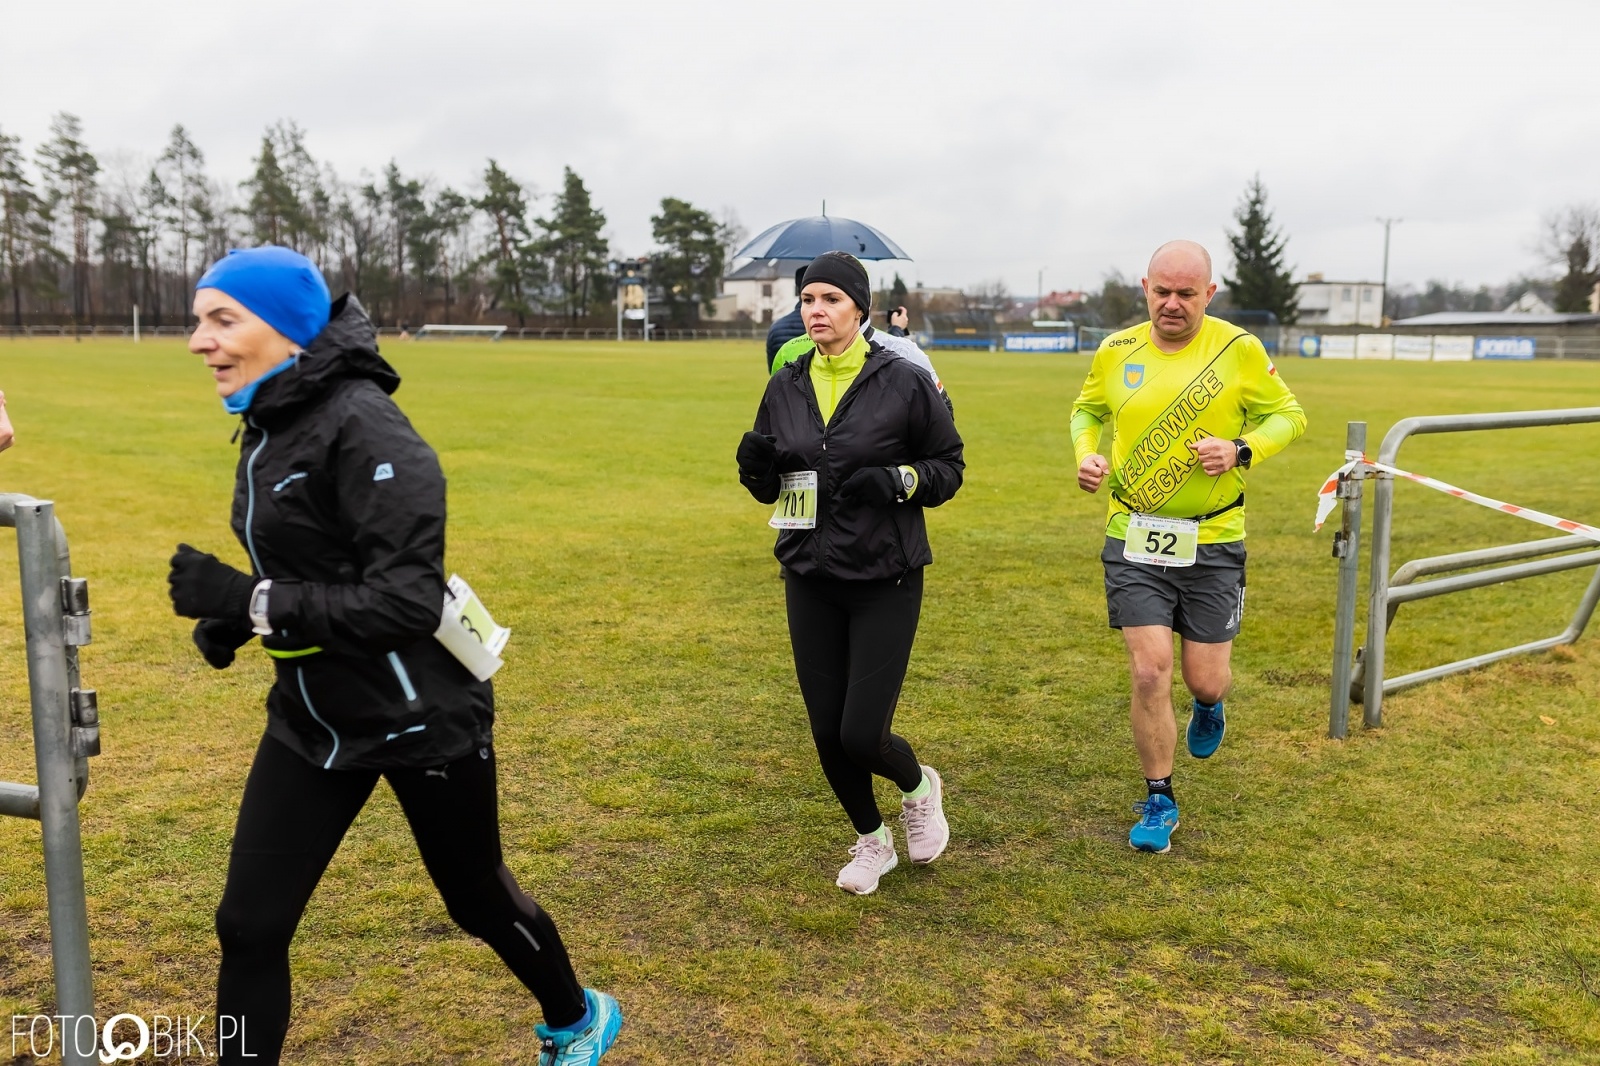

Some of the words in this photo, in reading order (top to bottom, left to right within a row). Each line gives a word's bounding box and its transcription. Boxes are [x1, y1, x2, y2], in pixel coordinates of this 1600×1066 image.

[1108, 337, 1137, 348] deep
[783, 490, 805, 517] 101
[1145, 531, 1178, 556] 52
